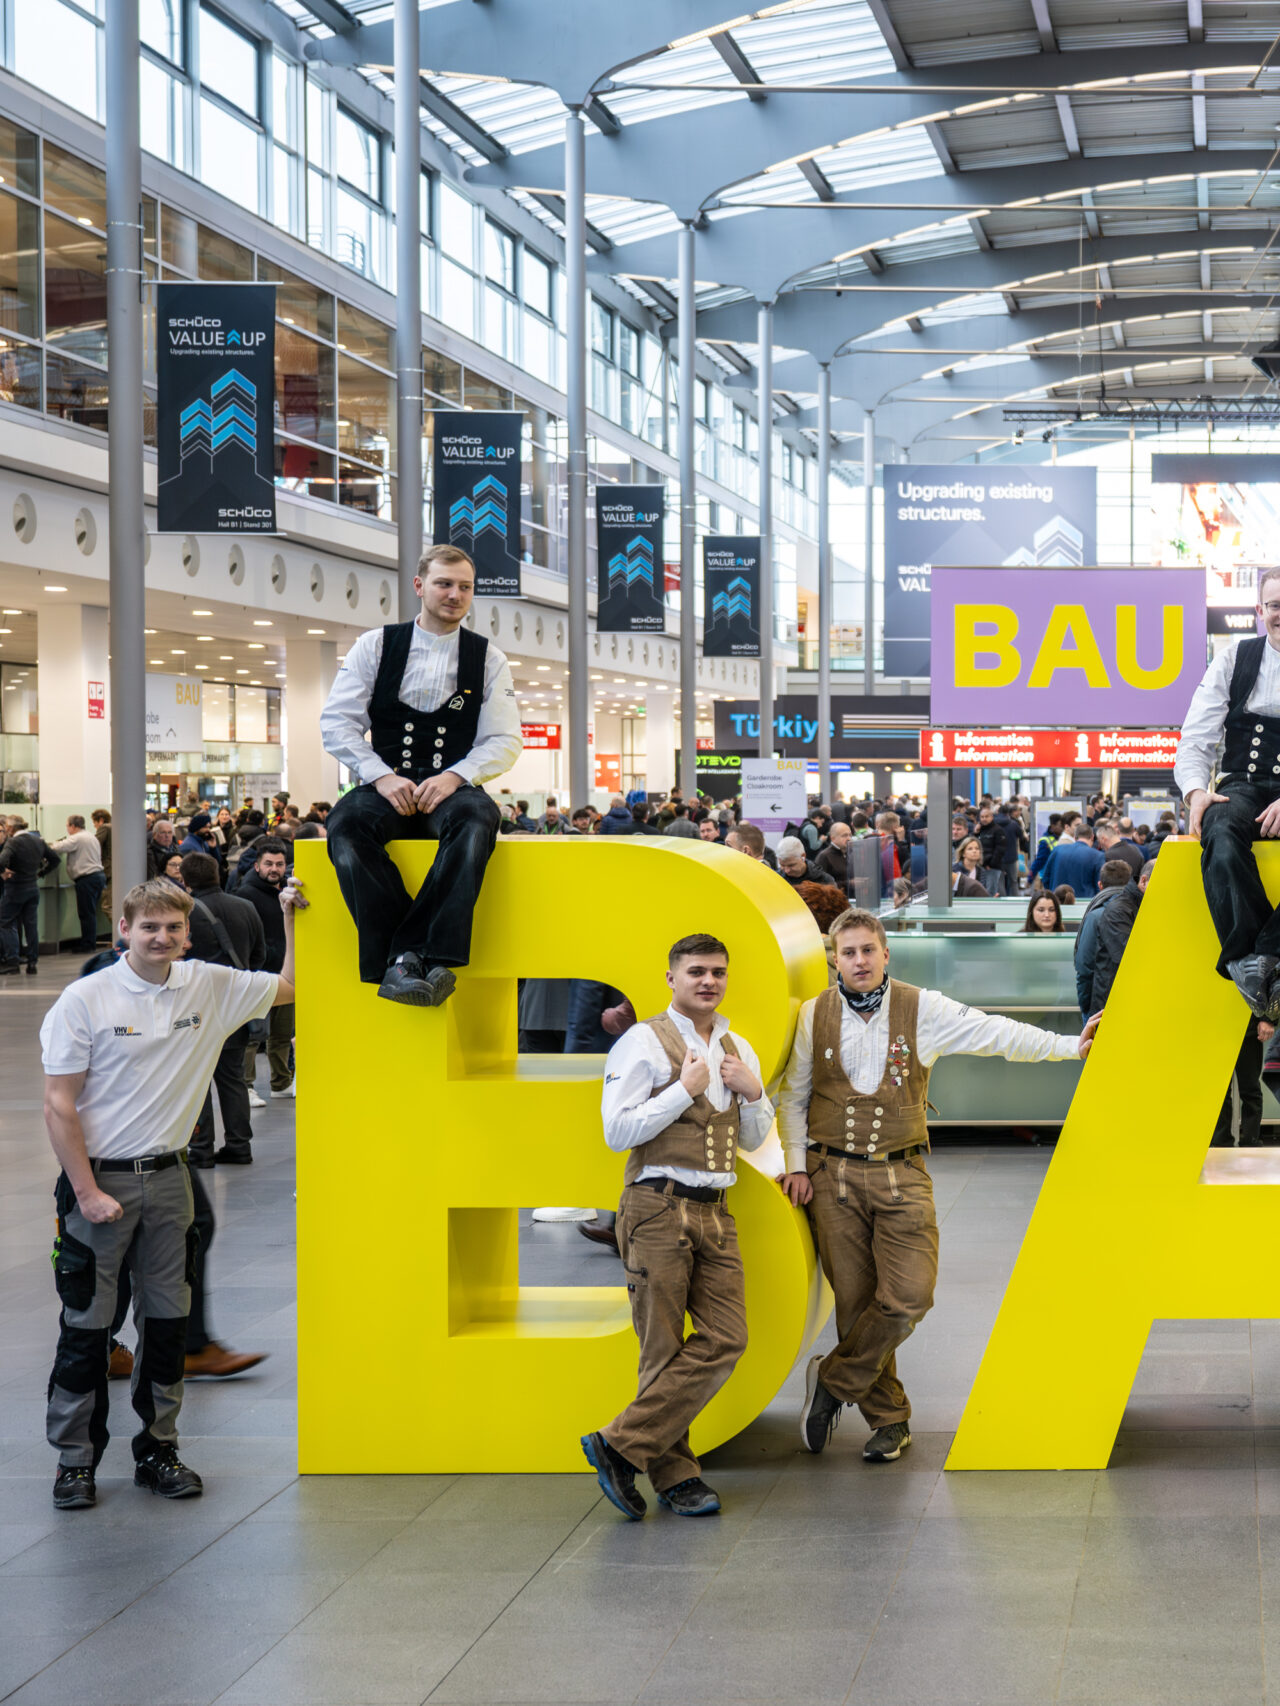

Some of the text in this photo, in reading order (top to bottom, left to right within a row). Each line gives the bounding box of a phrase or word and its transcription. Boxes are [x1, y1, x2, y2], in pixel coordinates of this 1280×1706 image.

[168, 316, 222, 327] SCHÜCO
[169, 331, 266, 346] VALUE UP
[170, 348, 200, 356] Upgrading
[442, 435, 482, 444] SCHÜCO
[442, 446, 515, 458] VALUE UP
[898, 482, 1053, 503] Upgrading existing
[218, 506, 272, 517] SCHÜCO
[602, 512, 659, 522] VALUE UP
[898, 506, 986, 521] structures.
[708, 558, 736, 566] VALUE
[898, 563, 931, 575] SCHÜ
[477, 577, 518, 586] SCHÜCO
[898, 577, 931, 592] VAL
[1224, 614, 1255, 628] VISIT
[954, 604, 1184, 690] BAU
[176, 683, 200, 706] BAU
[729, 713, 836, 743] Tükiy
[954, 732, 1034, 747] Information
[1099, 733, 1178, 748] Information
[955, 748, 1034, 763] Information
[777, 760, 802, 770] BAU
[113, 1026, 128, 1034] VHV
